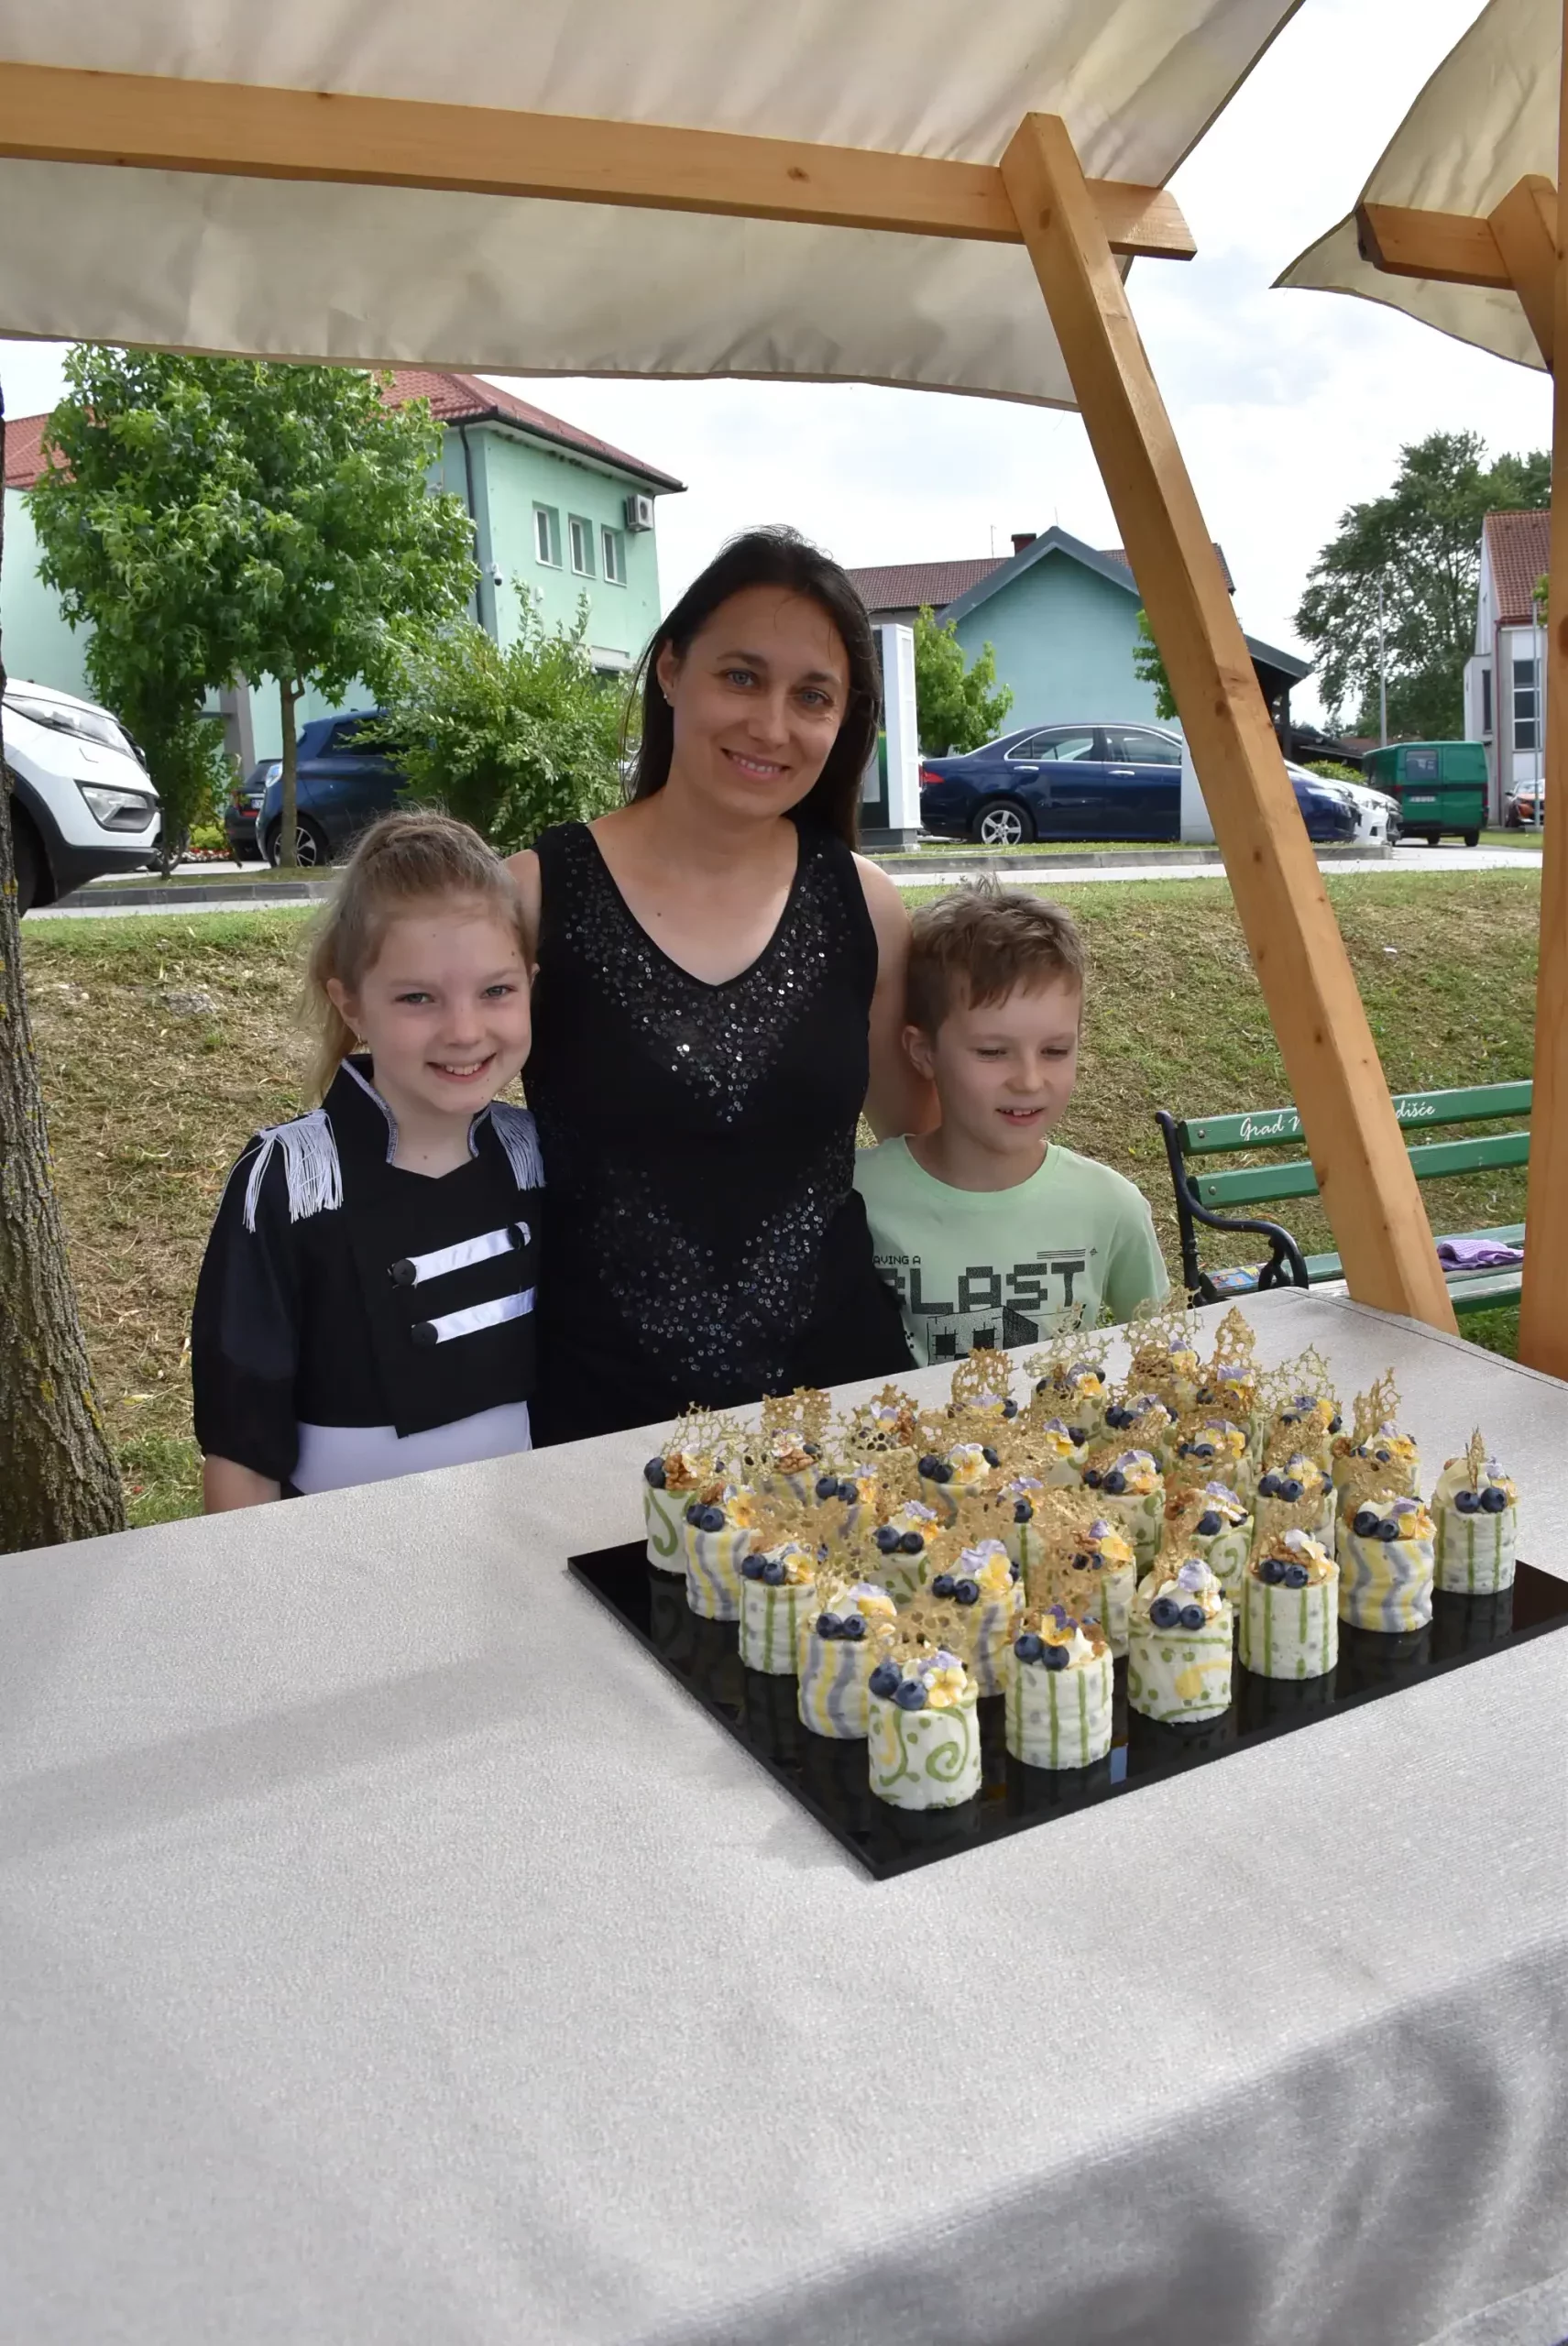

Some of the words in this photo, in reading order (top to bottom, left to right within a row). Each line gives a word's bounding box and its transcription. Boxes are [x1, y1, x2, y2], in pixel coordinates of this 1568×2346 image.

[1239, 1113, 1285, 1142] Grad
[1395, 1099, 1436, 1120] dišće
[872, 1255, 909, 1265] AVING
[912, 1255, 921, 1265] A
